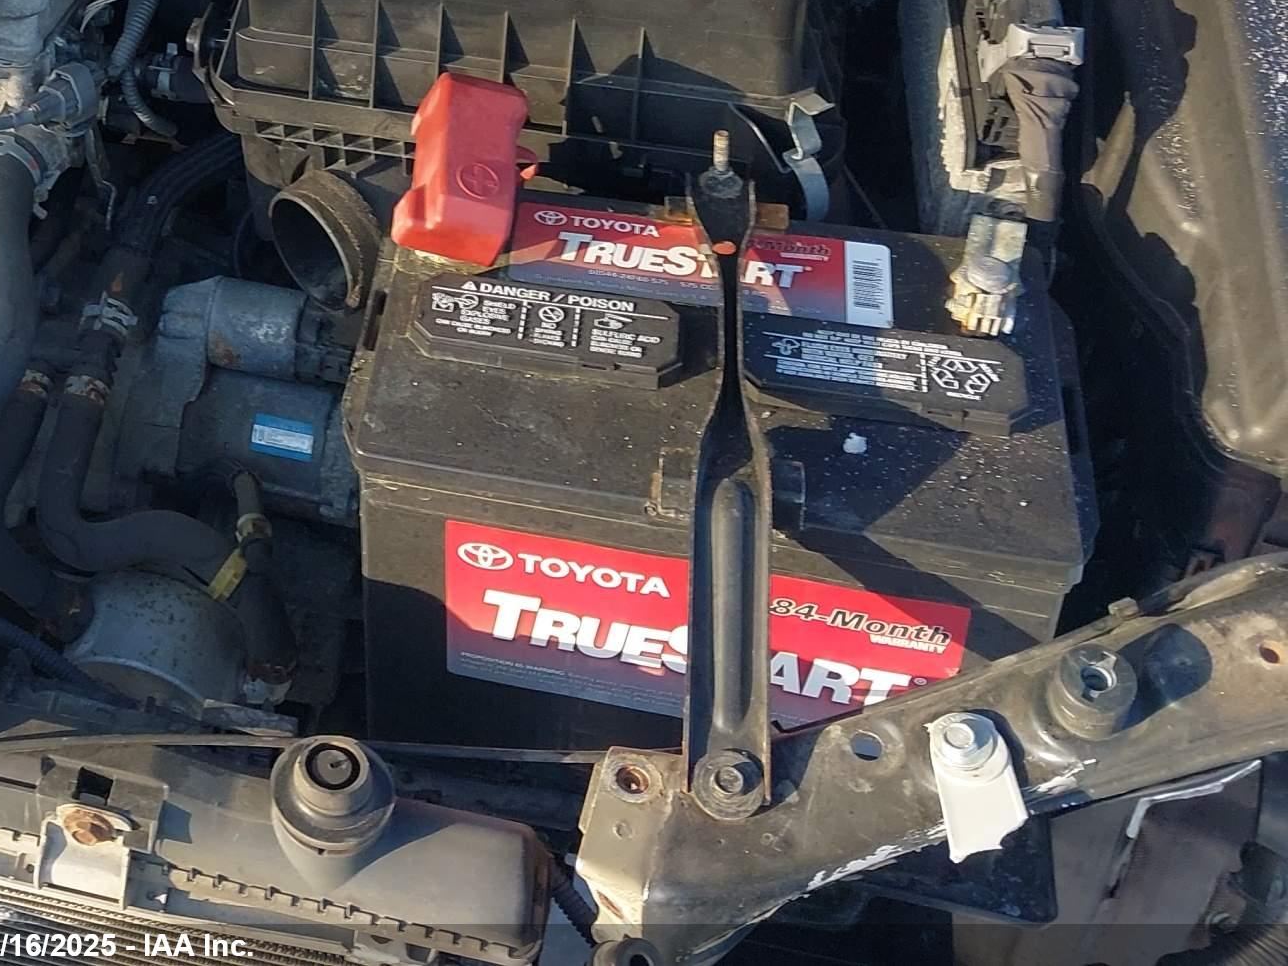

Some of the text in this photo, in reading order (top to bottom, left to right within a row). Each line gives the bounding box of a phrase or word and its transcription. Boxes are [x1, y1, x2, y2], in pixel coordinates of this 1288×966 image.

[570, 216, 661, 238] TOYOTA
[558, 231, 804, 288] TRUESTRT
[478, 283, 551, 302] DANGER
[568, 294, 634, 312] POISON
[517, 553, 670, 598] TOYOTA
[769, 598, 951, 647] 84-Month
[869, 633, 947, 655] WARRANTY
